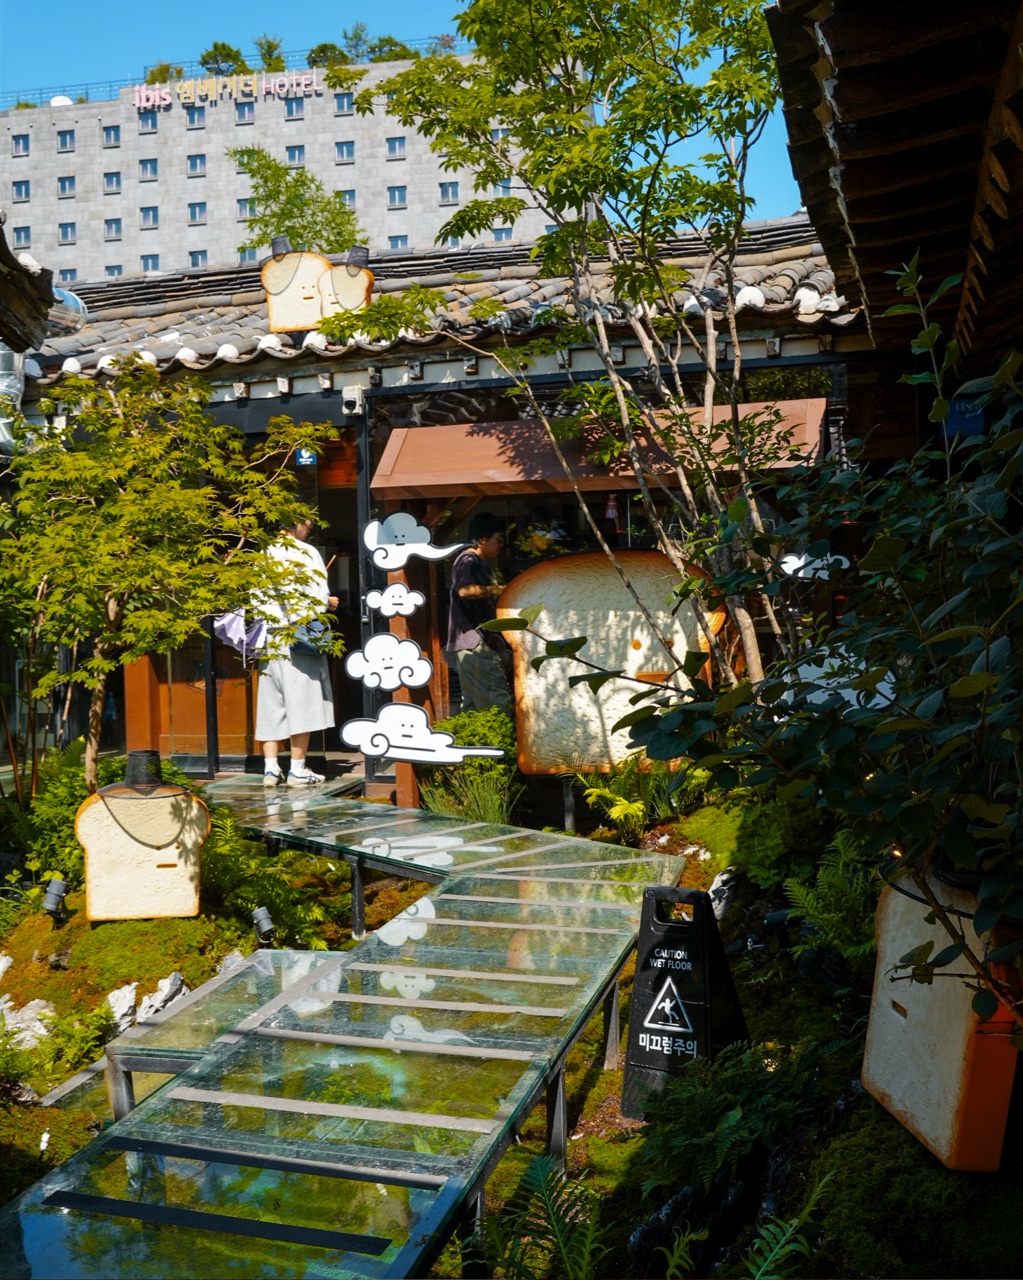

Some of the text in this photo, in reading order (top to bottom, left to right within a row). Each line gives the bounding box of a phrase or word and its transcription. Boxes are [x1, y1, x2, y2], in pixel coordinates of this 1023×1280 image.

[134, 83, 172, 108] ibis
[262, 71, 323, 95] HOTEL
[649, 957, 692, 971] WET FLOOR
[654, 948, 688, 960] CAUTION
[638, 1033, 697, 1059] 미끄럼주의
